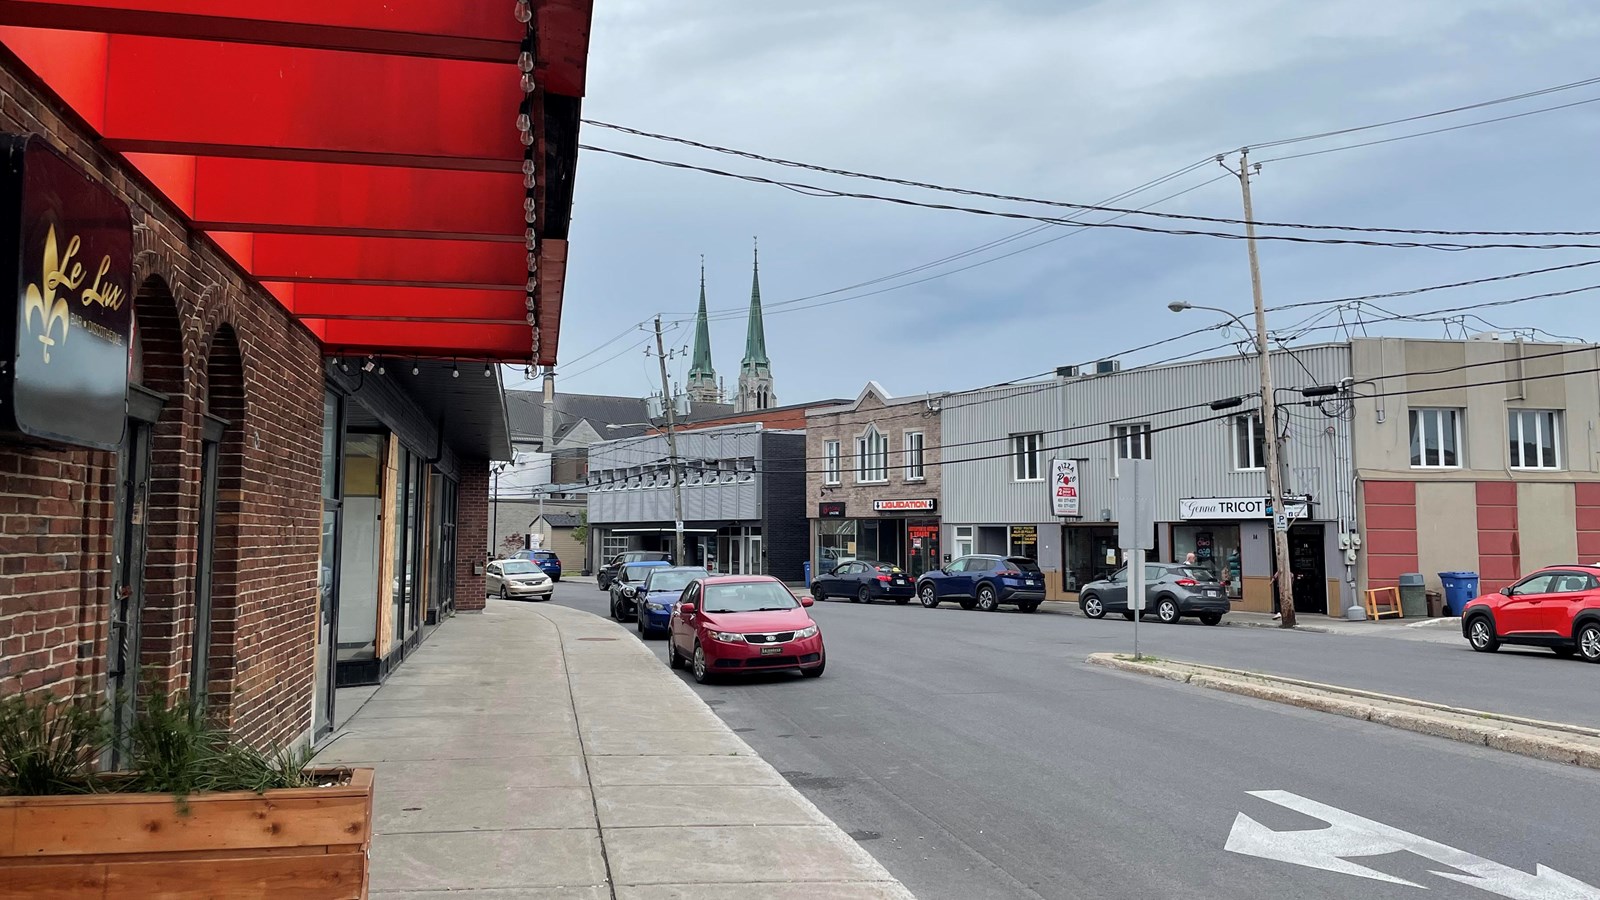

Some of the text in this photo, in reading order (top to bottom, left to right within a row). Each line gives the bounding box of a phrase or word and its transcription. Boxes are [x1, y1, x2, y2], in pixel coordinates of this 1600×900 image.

[48, 234, 126, 311] Le Lux
[70, 312, 82, 328] BAR
[1057, 462, 1075, 472] PIZZA
[881, 501, 928, 509] LIQUIDATION
[1219, 501, 1262, 512] TRICOT
